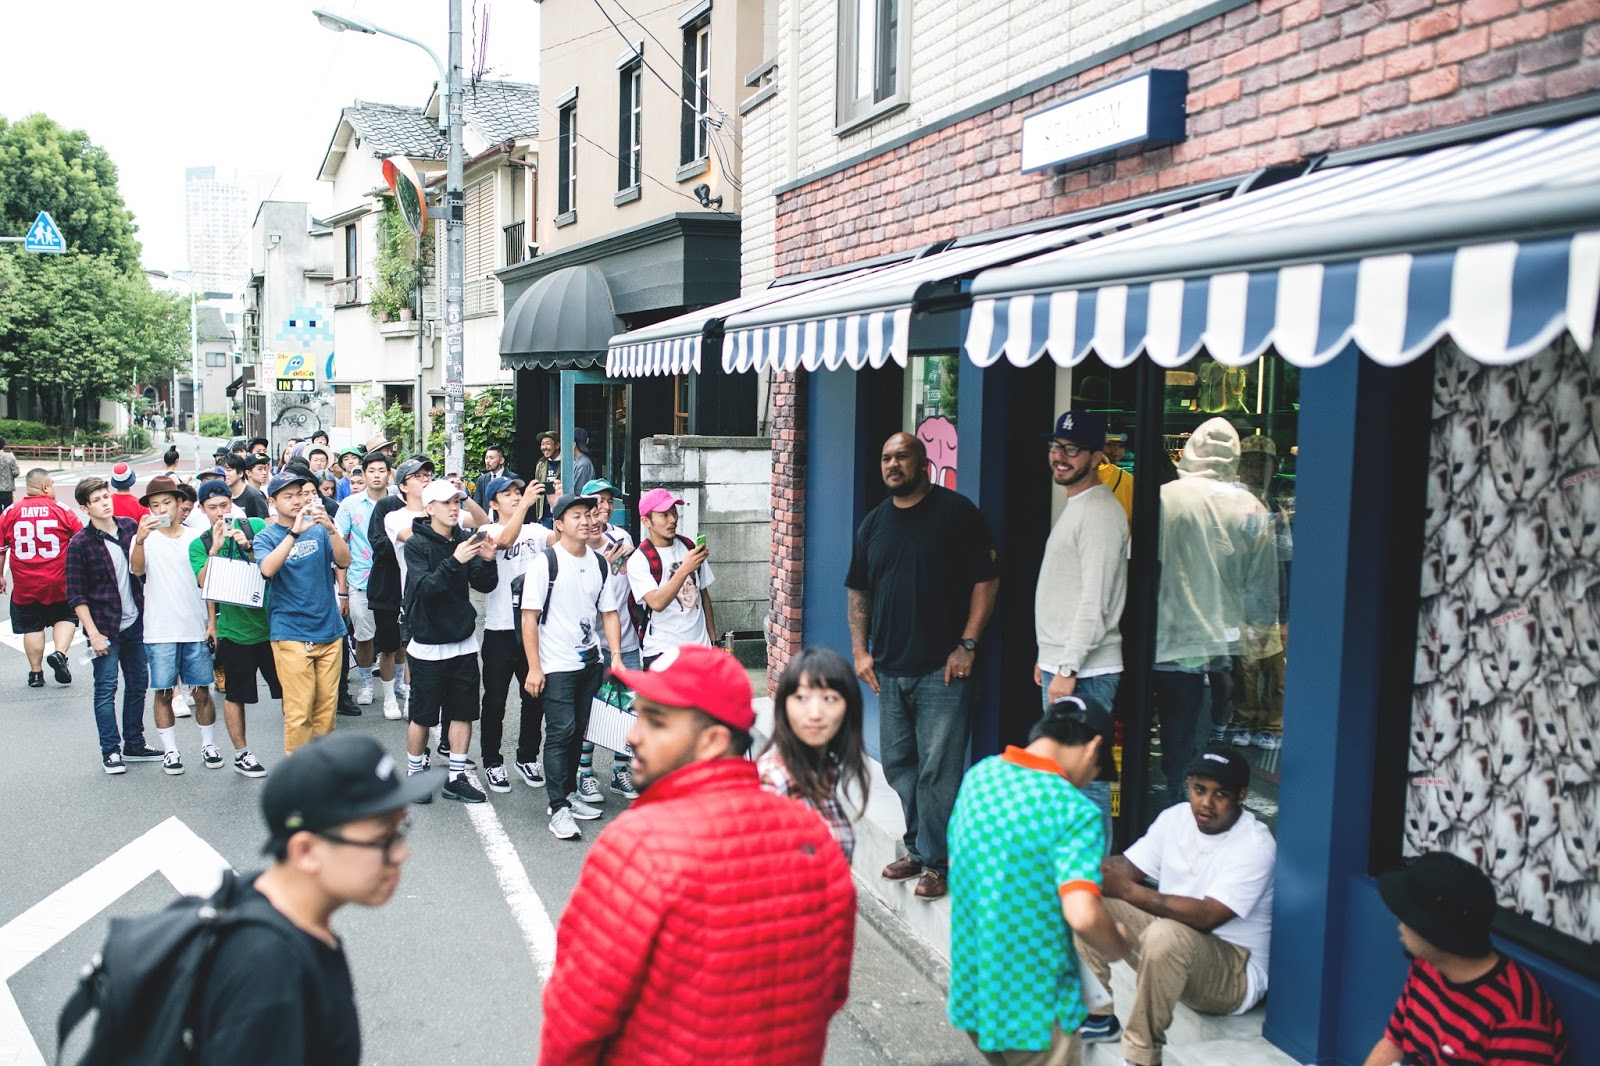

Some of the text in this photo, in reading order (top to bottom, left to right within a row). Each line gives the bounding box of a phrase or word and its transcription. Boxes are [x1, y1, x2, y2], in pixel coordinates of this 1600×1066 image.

[278, 380, 291, 390] IN
[20, 506, 49, 518] DAVIS
[13, 519, 61, 560] 85
